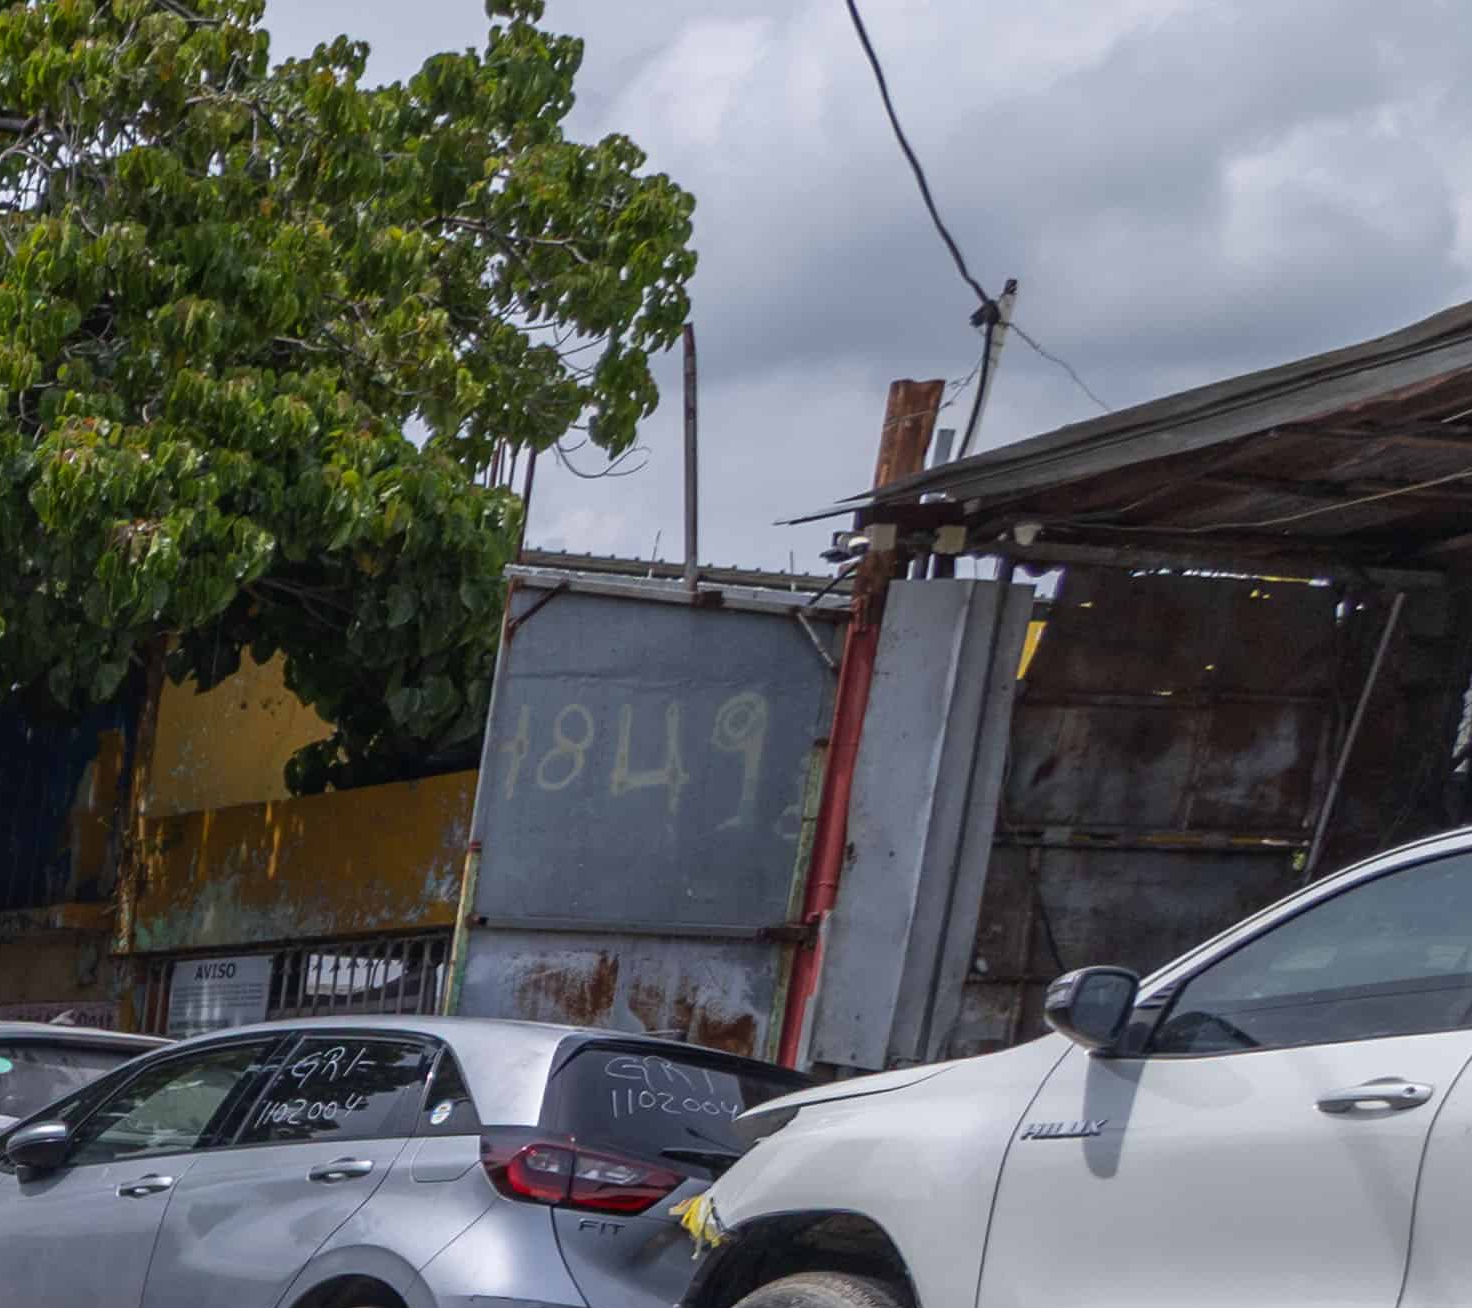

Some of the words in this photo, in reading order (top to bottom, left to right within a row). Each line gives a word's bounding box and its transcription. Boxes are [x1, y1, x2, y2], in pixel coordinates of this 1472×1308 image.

[497, 691, 769, 832] 1849
[193, 962, 236, 982] AVISO
[1020, 1119, 1109, 1140] HILUX
[578, 1219, 626, 1237] FIT
